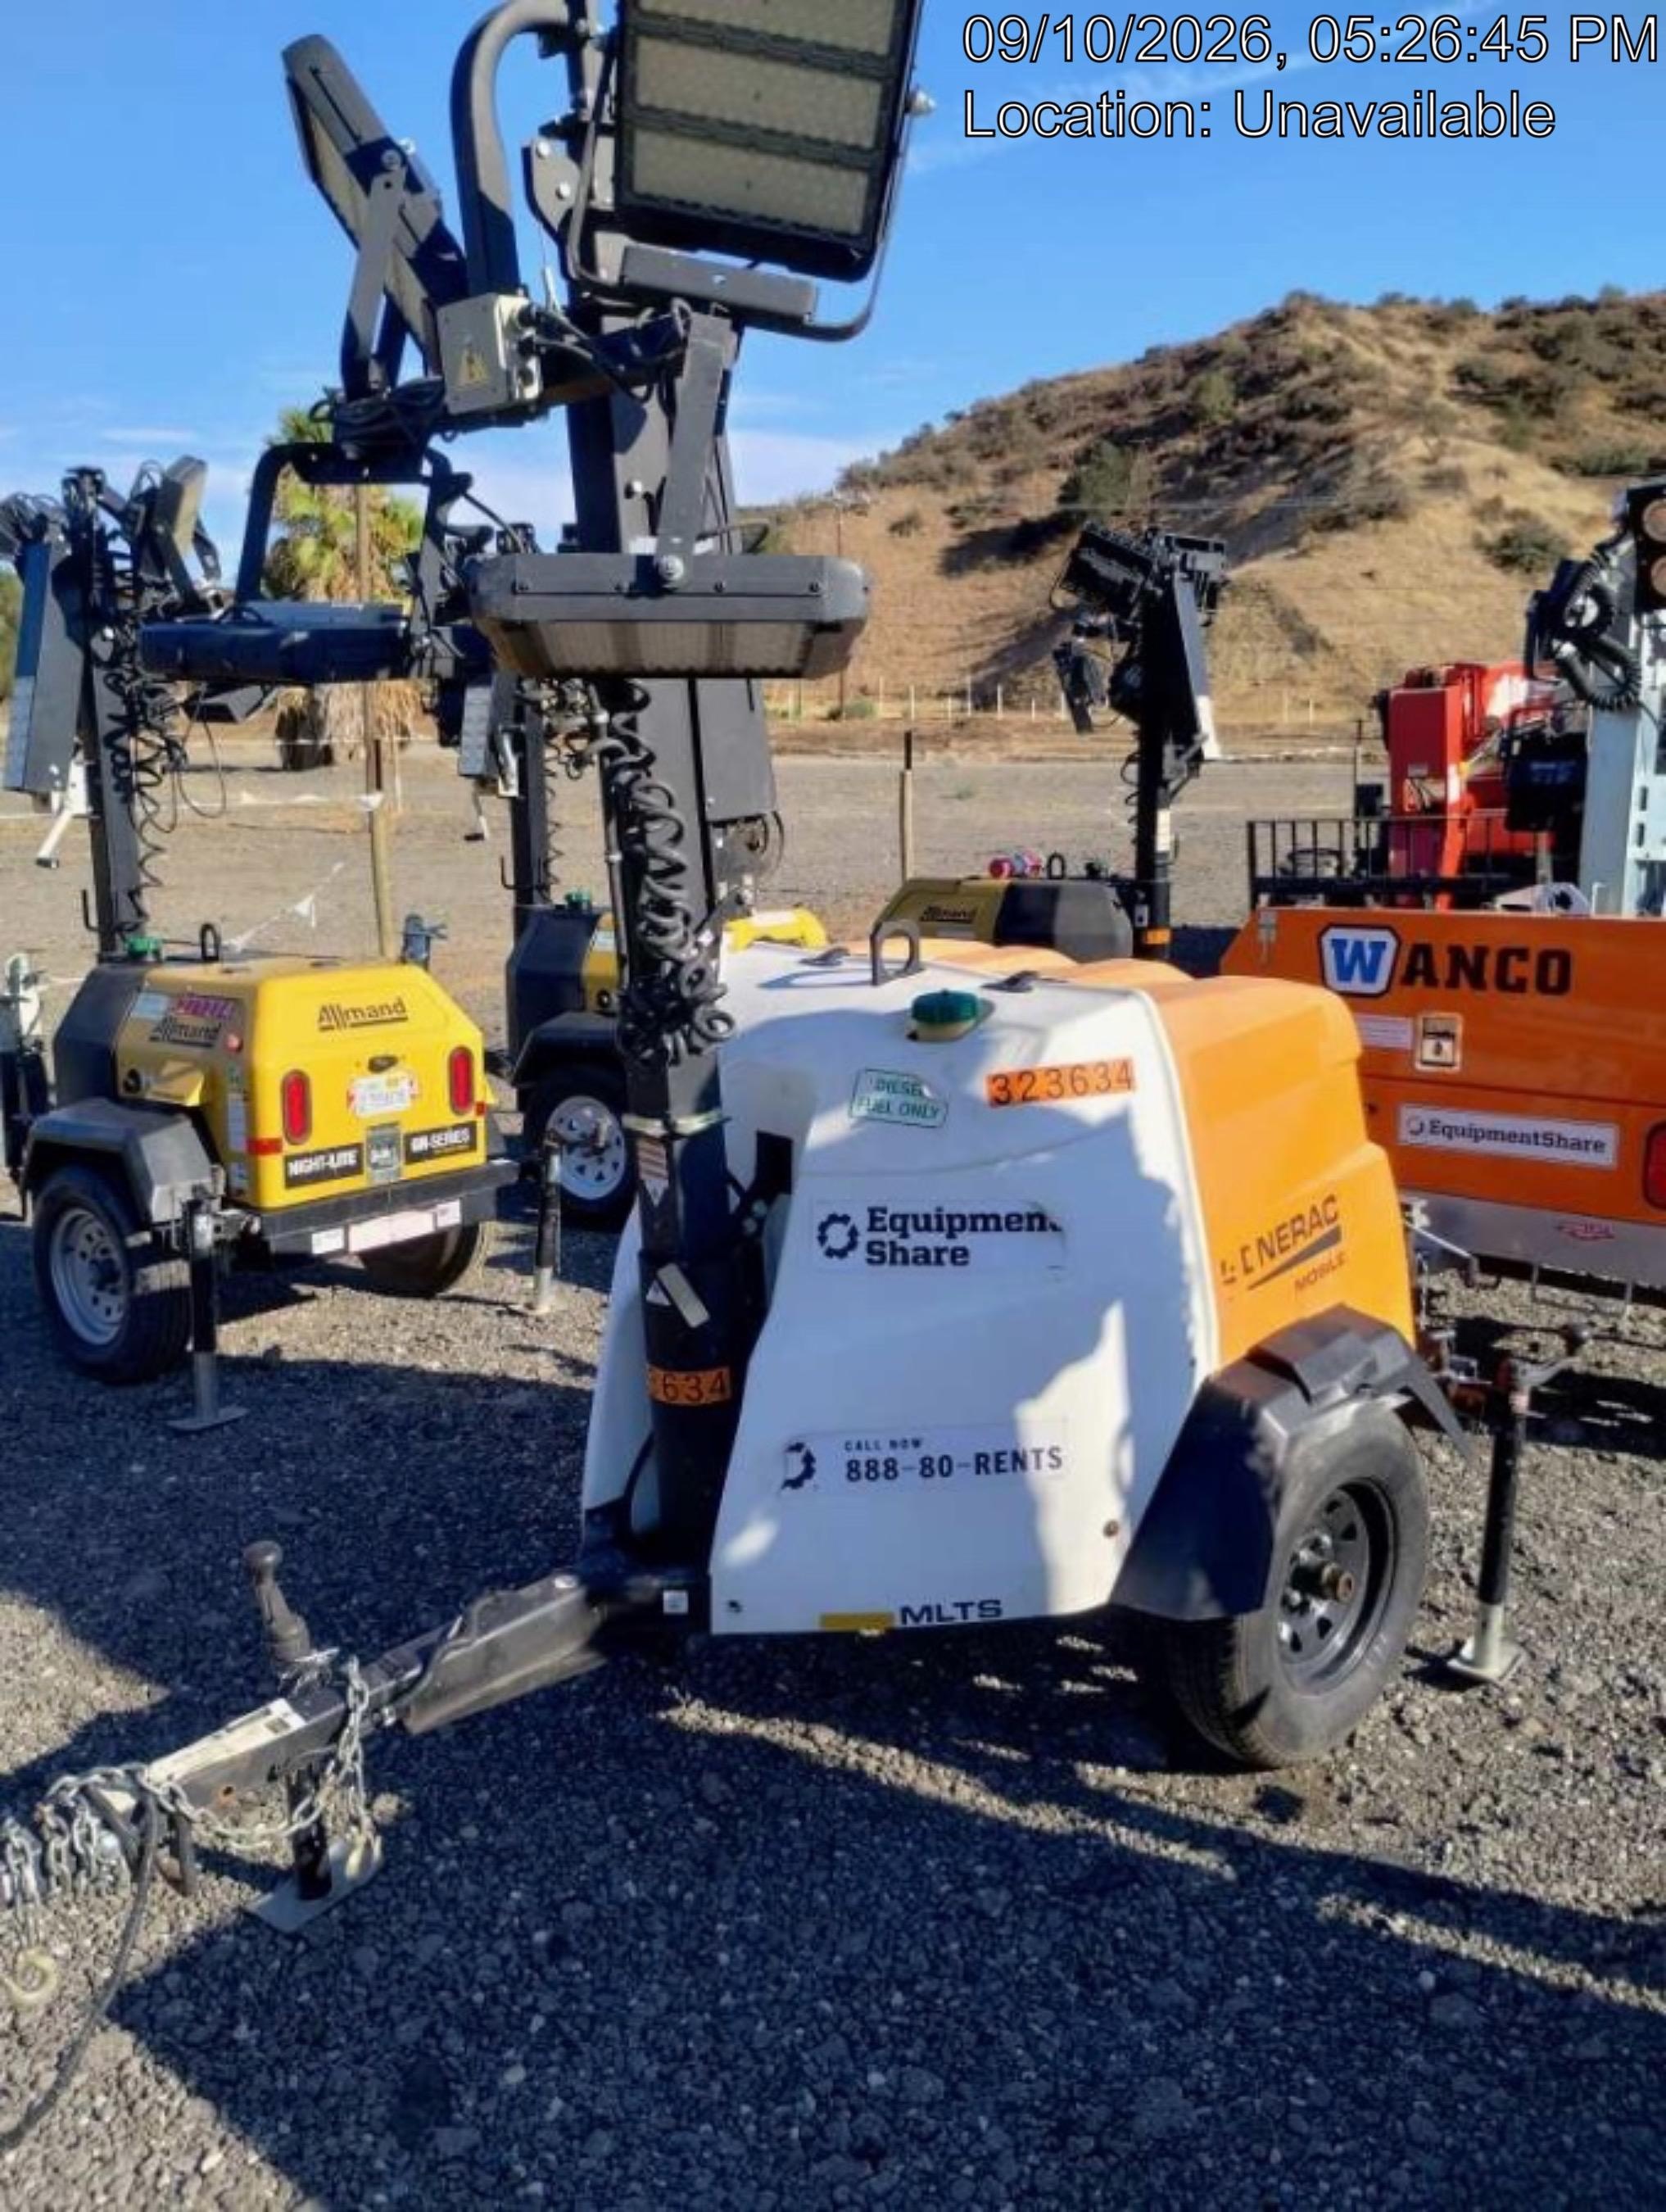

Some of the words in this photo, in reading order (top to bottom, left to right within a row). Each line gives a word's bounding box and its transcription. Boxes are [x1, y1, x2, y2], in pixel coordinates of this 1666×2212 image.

[1330, 937, 1572, 995] WANCO
[318, 996, 408, 1031] Allmand
[989, 1060, 1134, 1105] 323634
[899, 1101, 940, 1120] ONLY
[1428, 1119, 1607, 1154] EquipmentShare
[865, 1240, 971, 1267] Share
[844, 1439, 883, 1452] CALL
[889, 1438, 924, 1450] NOW
[845, 1445, 1063, 1483] 888-80-RENTS
[900, 1598, 1003, 1626] MLTS
